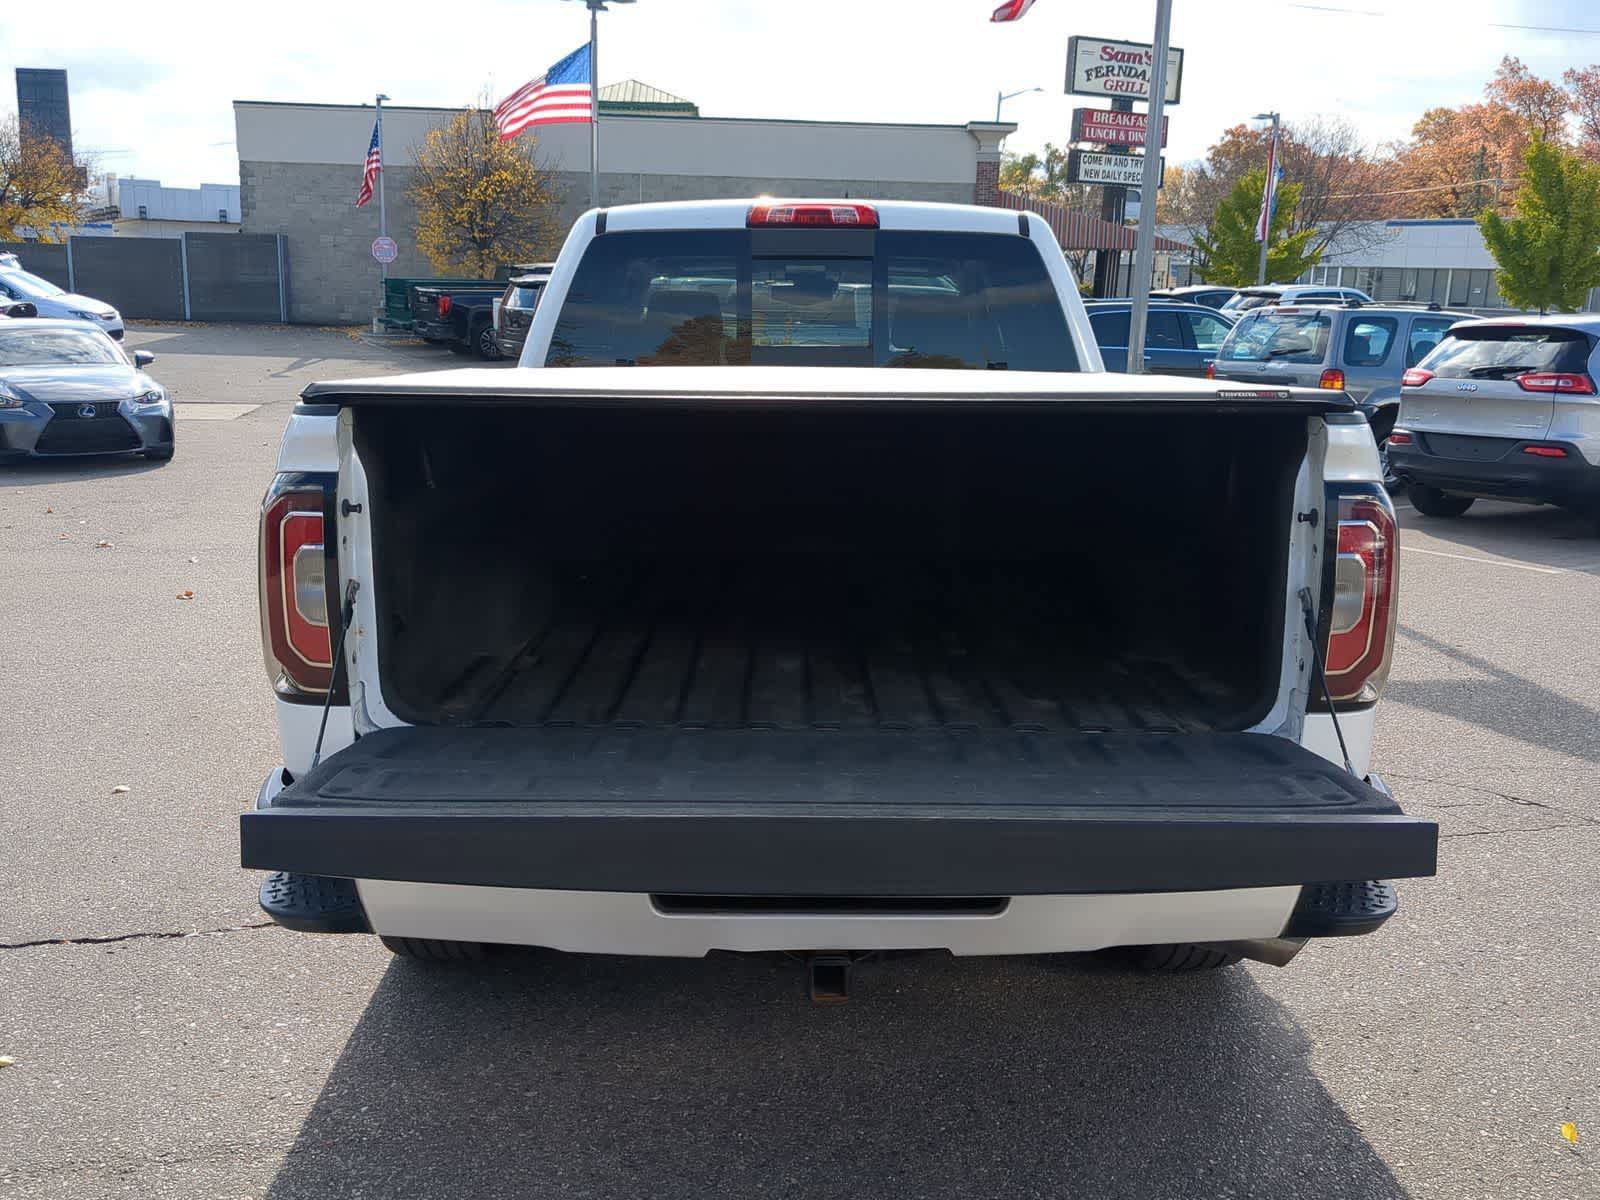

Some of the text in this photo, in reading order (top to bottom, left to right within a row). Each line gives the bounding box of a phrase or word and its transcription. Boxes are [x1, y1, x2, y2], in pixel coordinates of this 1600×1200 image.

[1099, 45, 1152, 65] Sam's
[1085, 64, 1150, 83] FERNDA
[1103, 78, 1147, 95] GRILL
[1092, 111, 1148, 128] BREAKFAS
[1086, 127, 1116, 140] LUNCH
[1118, 131, 1125, 141] &
[1082, 155, 1144, 169] COME IN AND TRY
[1083, 168, 1101, 179] NEW
[1101, 169, 1122, 181] DAILY
[1456, 383, 1478, 393] Jeep
